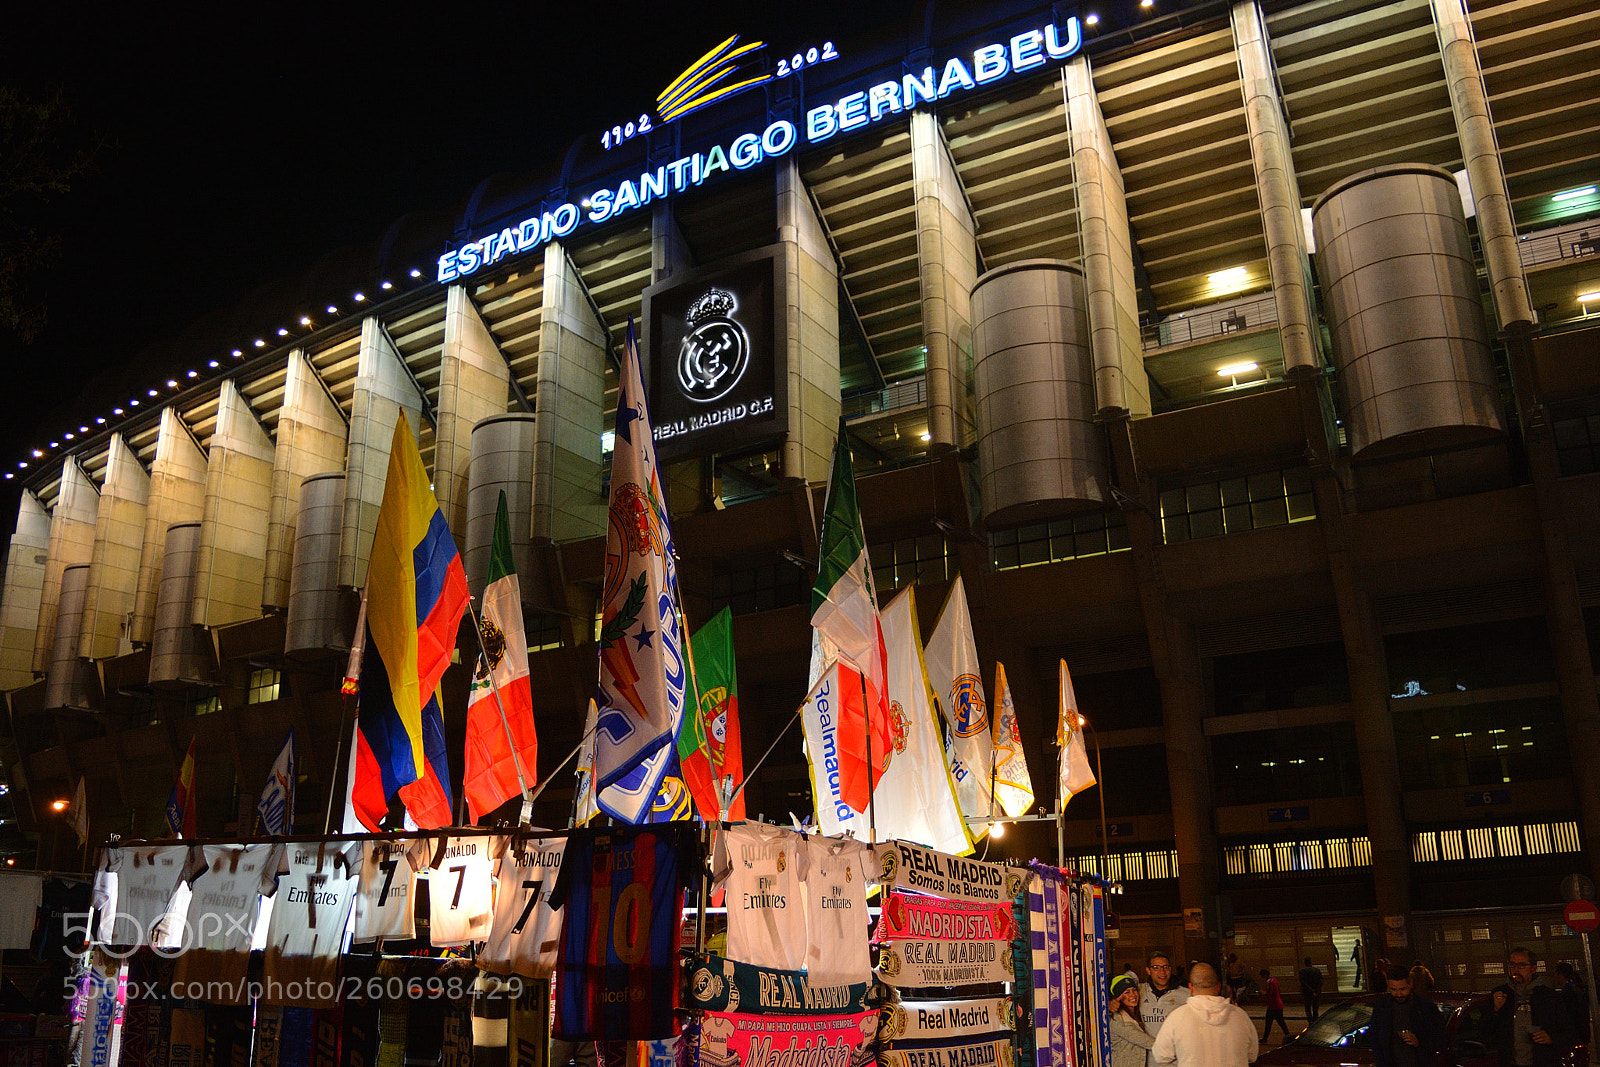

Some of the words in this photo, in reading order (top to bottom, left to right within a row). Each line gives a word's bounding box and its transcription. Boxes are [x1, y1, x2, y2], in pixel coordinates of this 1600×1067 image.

[775, 41, 840, 78] 2002
[600, 113, 653, 150] 1902
[437, 202, 581, 284] ESTADIO
[588, 119, 797, 223] SANTIAGO
[806, 16, 1083, 144] BERNABEU
[653, 420, 688, 440] REAL
[689, 403, 747, 431] MADRID
[1482, 792, 1492, 803] 6
[1284, 808, 1292, 820] 4
[1110, 824, 1118, 836] 2
[606, 849, 642, 871] MESSI
[900, 845, 944, 877] REAL
[947, 857, 1002, 887] MADRID
[310, 875, 325, 889] Fly
[377, 859, 399, 907] 7
[449, 865, 467, 910] 7
[759, 877, 772, 892] Fly
[832, 885, 842, 897] Fly
[908, 869, 944, 892] Somos
[947, 880, 961, 894] los
[963, 881, 999, 900] Blancos
[287, 886, 339, 906] Emirates
[511, 880, 543, 935] 7
[821, 895, 852, 909] Emirates
[592, 882, 653, 967] 10
[907, 908, 993, 939] MADRIDISTA
[904, 942, 944, 964] REAL
[948, 942, 996, 964] MADRID
[758, 971, 801, 1009] REAL
[737, 1019, 746, 1030] MI
[766, 1021, 776, 1032] ME
[776, 1021, 791, 1032] HIZO
[813, 1021, 827, 1031] LISTA
[827, 1020, 833, 1030] Y
[918, 1008, 947, 1030] Real
[949, 1005, 990, 1028] Madrid
[947, 1044, 996, 1067] MADRID
